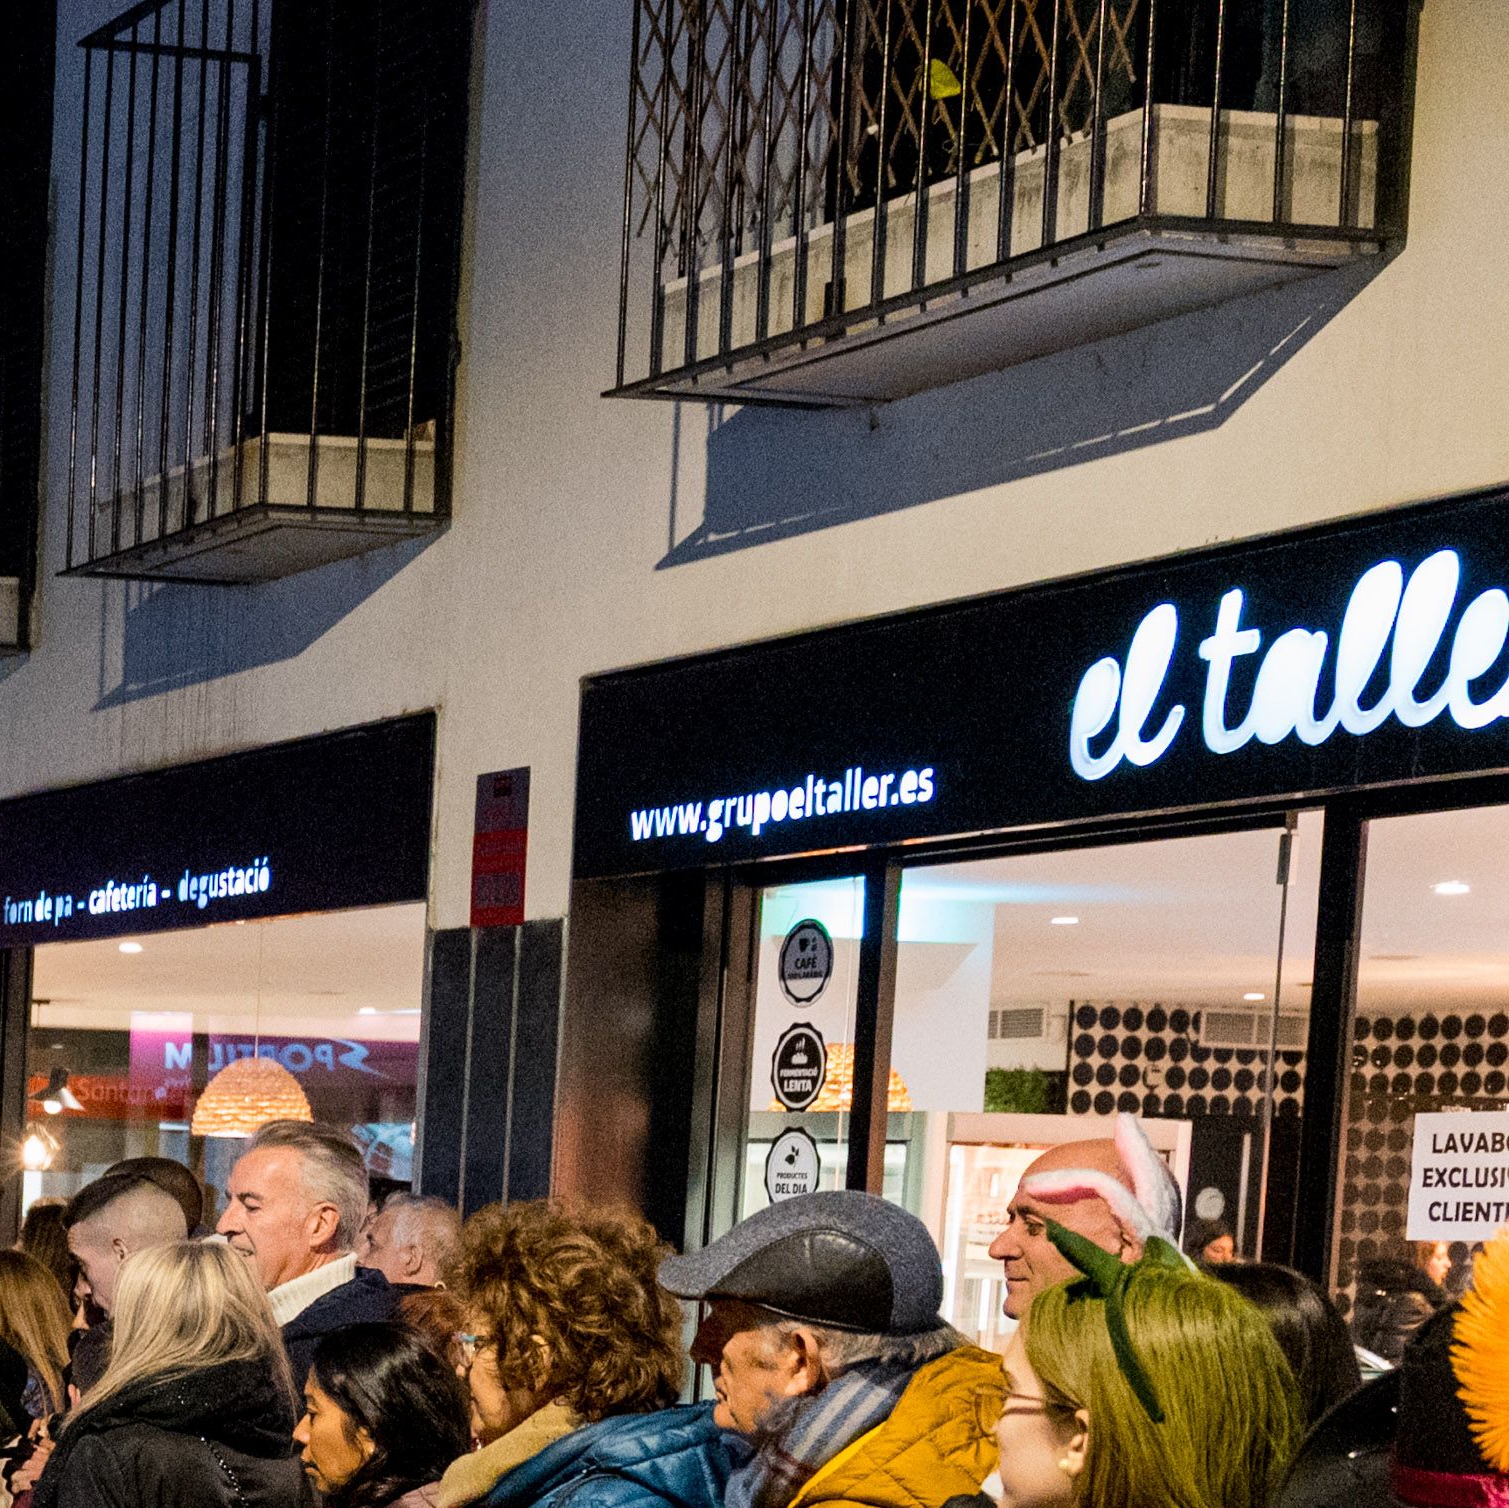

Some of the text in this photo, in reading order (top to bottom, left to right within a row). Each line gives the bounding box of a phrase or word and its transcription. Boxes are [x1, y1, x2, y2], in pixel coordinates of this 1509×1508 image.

[1069, 603, 1185, 781] el
[631, 767, 934, 842] www.grupoeltaller.es
[4, 896, 32, 925] forn
[34, 890, 53, 923] de
[54, 894, 72, 926] pa
[88, 874, 157, 915] cafetería
[178, 856, 271, 909] degustació
[784, 1079, 813, 1093] LENTA
[775, 1183, 808, 1194] DEL DIA
[1422, 1167, 1509, 1188] EXCLUSI
